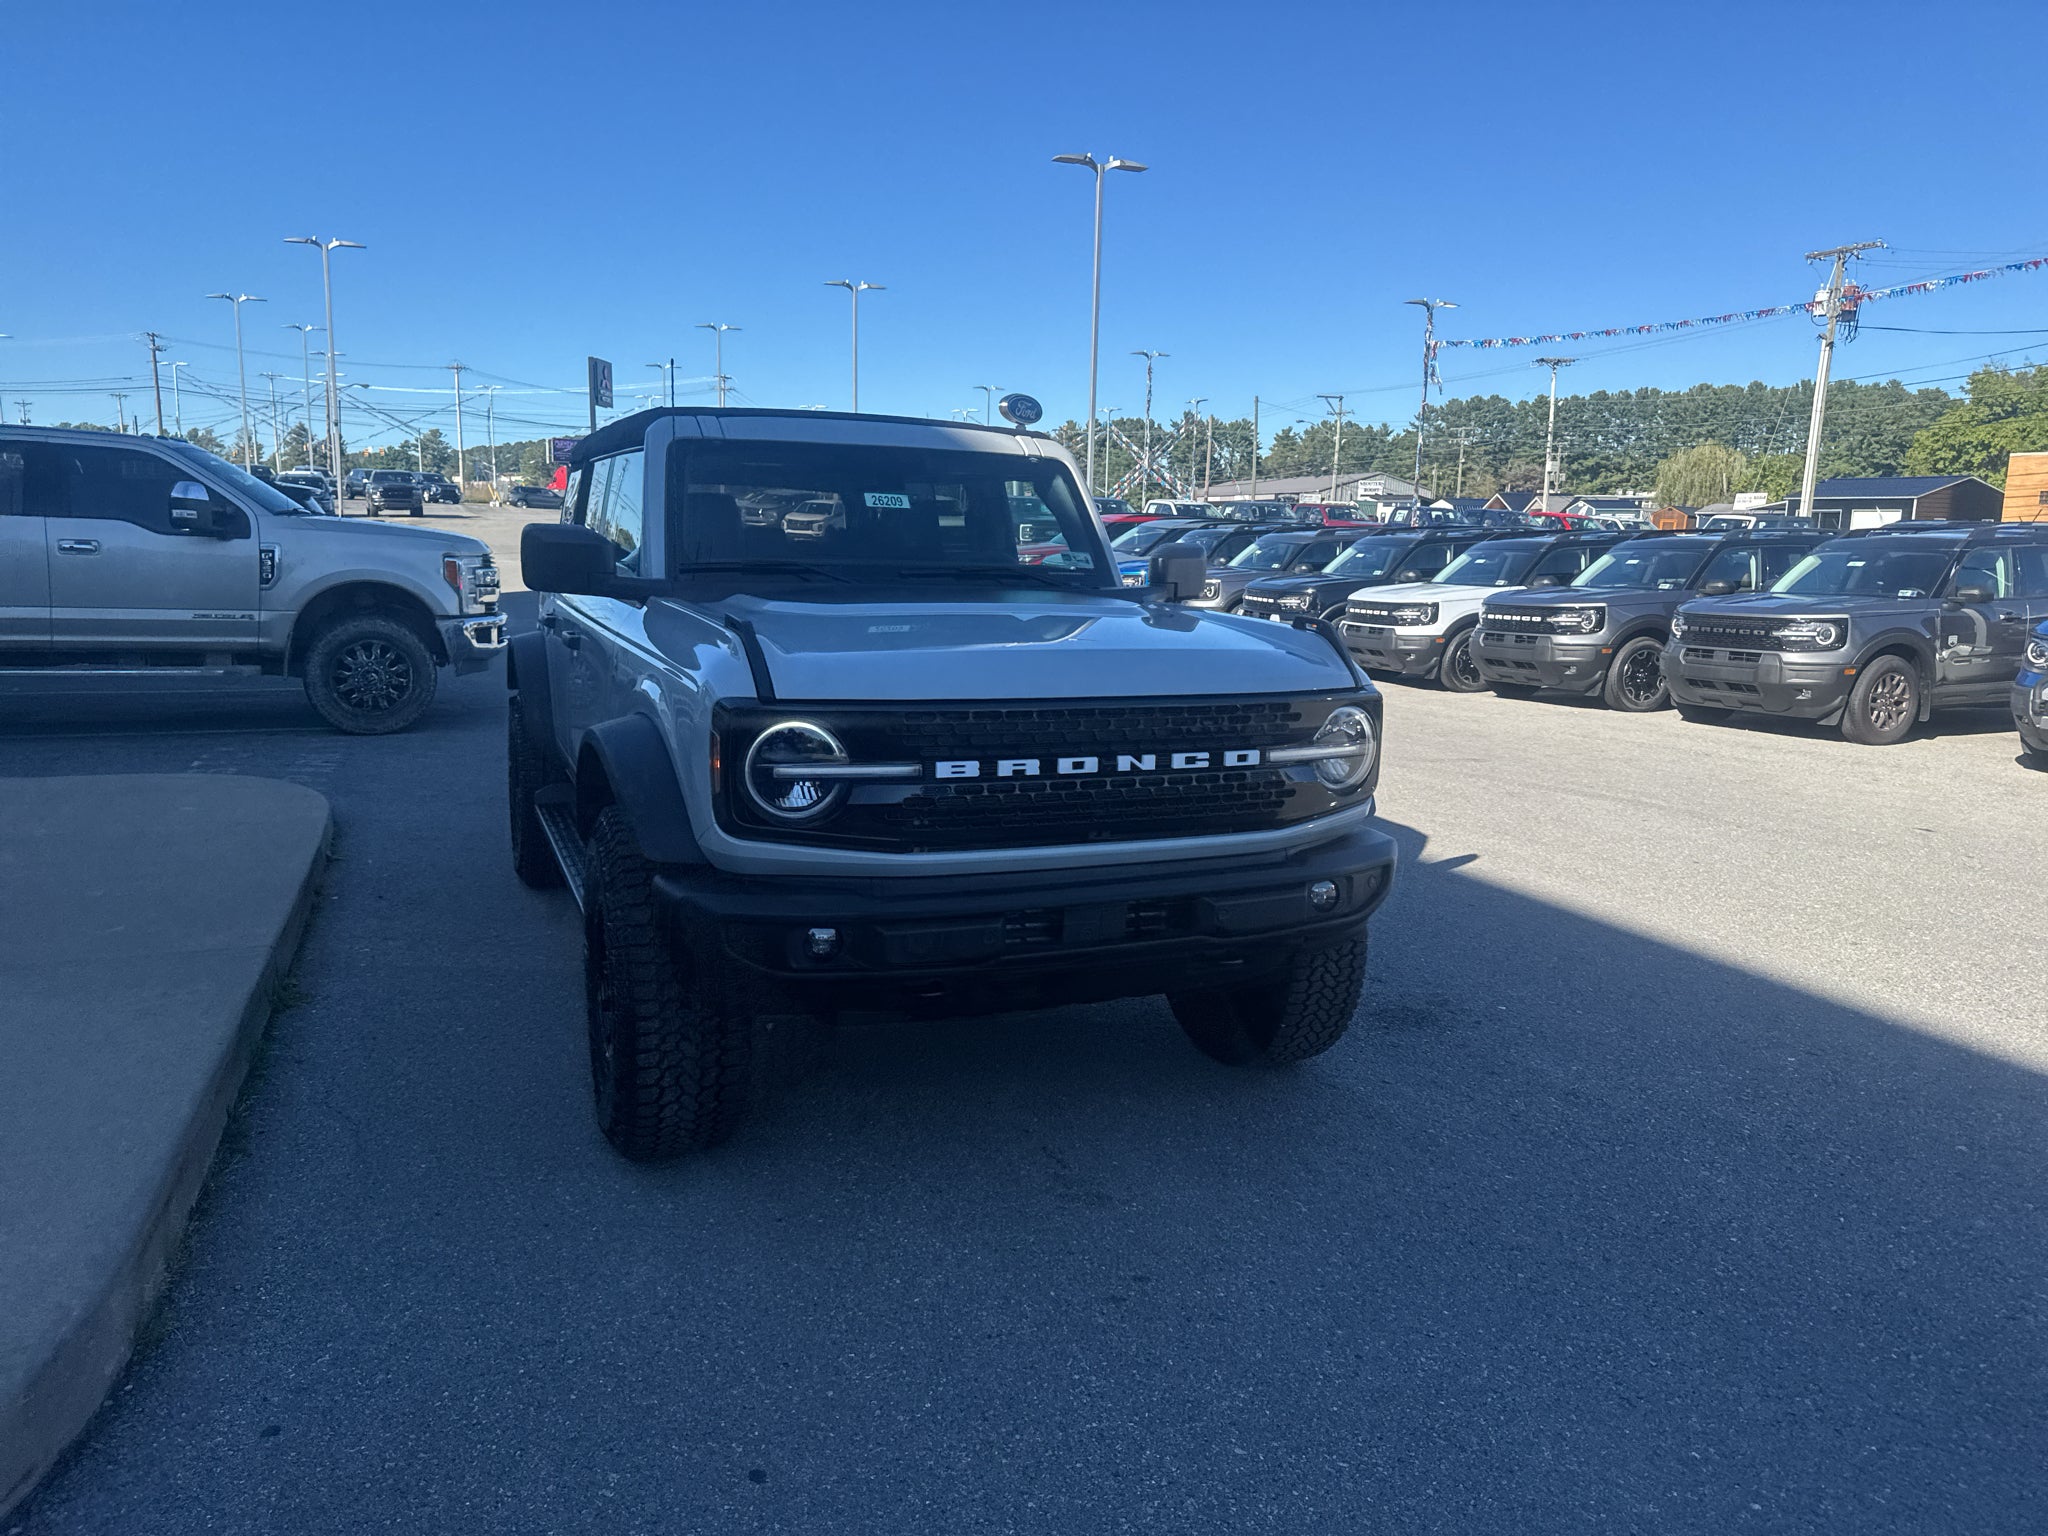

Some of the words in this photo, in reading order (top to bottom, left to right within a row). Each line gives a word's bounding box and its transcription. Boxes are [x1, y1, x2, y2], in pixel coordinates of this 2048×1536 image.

[1015, 400, 1038, 419] Ford
[871, 495, 904, 507] 26209
[1487, 613, 1542, 622] BRONCO
[1689, 625, 1766, 636] BRONCO
[935, 749, 1261, 779] BRONCO
